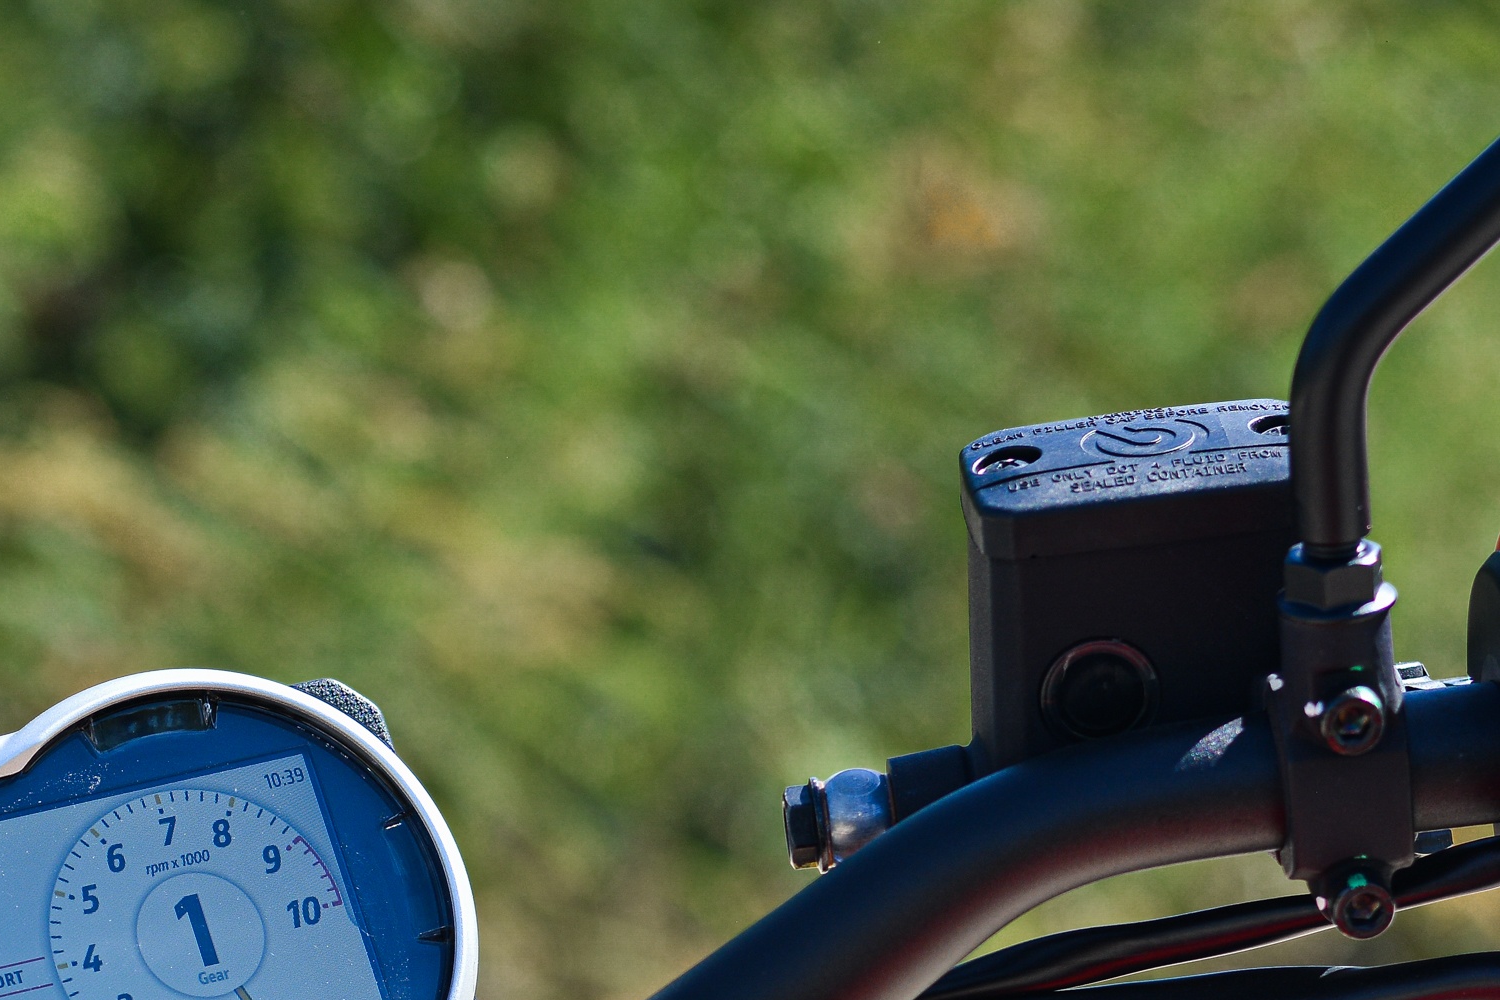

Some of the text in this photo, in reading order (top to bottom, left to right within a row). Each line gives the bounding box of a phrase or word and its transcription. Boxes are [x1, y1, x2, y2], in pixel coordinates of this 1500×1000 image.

[970, 432, 1024, 450] CLEAN
[1032, 419, 1097, 436] FILLER
[1144, 406, 1209, 421] BEFORE
[1216, 402, 1290, 413] REMOVIN
[1007, 449, 1283, 493] USE ONLY DOT 4 FLUID FROM
[1070, 462, 1248, 494] SEALED CONTAINER
[263, 767, 304, 790] 10:39
[158, 815, 176, 846] 7
[212, 818, 232, 848] 8
[106, 843, 126, 873] 6
[146, 860, 169, 876] rpm
[180, 849, 210, 867] 1000
[262, 844, 282, 874] 9
[81, 883, 100, 915] 5
[286, 896, 321, 928] 10
[174, 893, 220, 967] 1
[82, 943, 103, 972] 4
[198, 968, 230, 985] Gear
